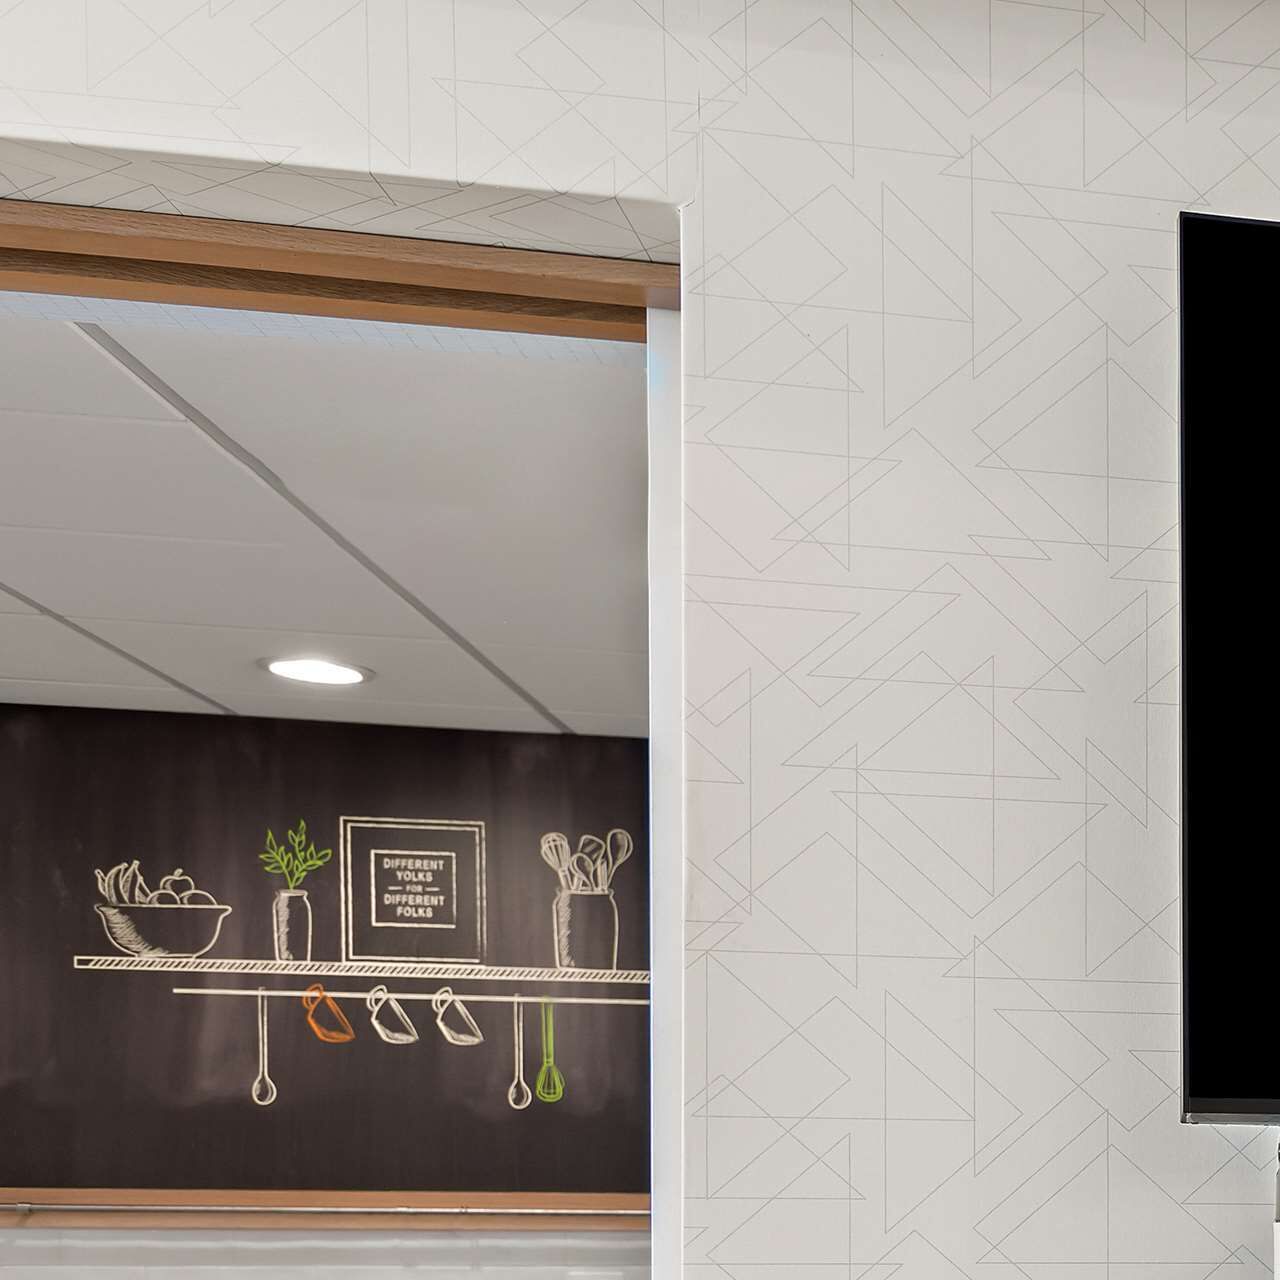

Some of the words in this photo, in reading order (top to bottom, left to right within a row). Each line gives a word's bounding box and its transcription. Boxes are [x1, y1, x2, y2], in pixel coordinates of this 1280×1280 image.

[383, 858, 444, 870] DIFFERENT
[396, 870, 433, 882] YOLKS
[384, 894, 445, 906] DIFFERENT
[396, 906, 432, 918] FOLKS
